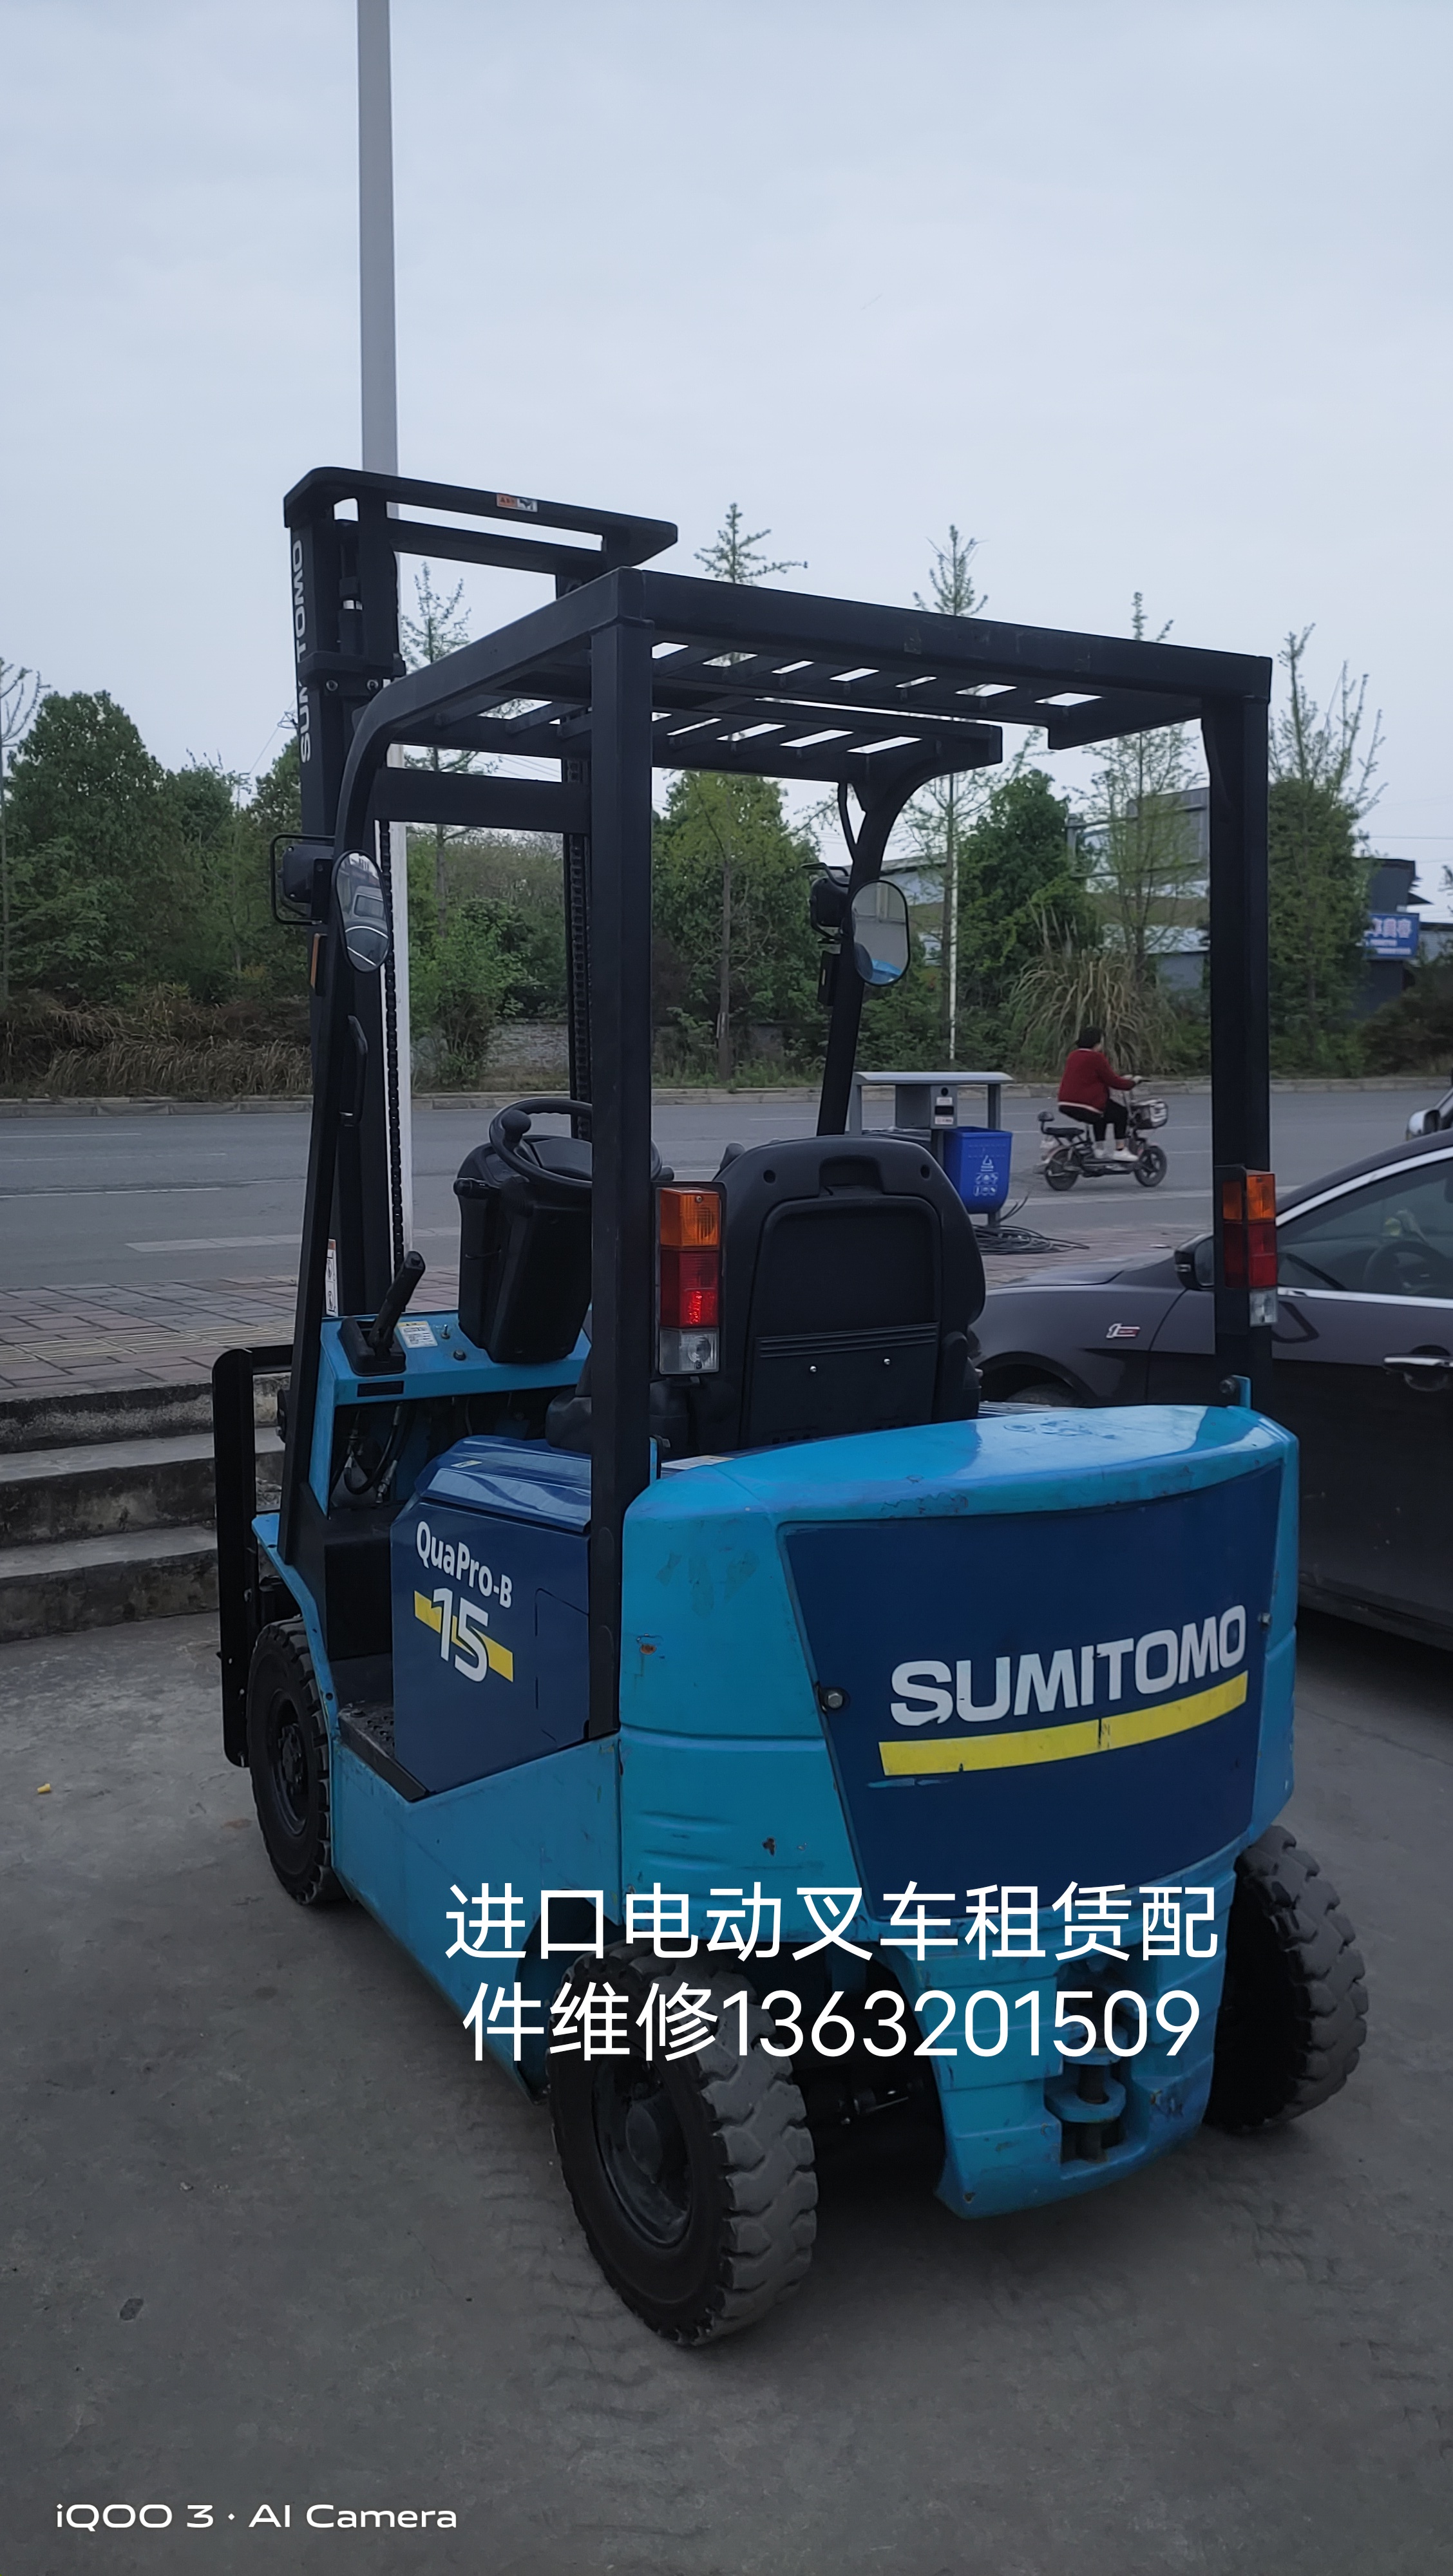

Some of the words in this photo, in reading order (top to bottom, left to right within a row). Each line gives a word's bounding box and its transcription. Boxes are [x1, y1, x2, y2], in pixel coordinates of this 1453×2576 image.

[416, 1520, 513, 1609] QuaPro-B
[432, 1587, 489, 1682] 15
[889, 1604, 1247, 1727] SUMITOMO
